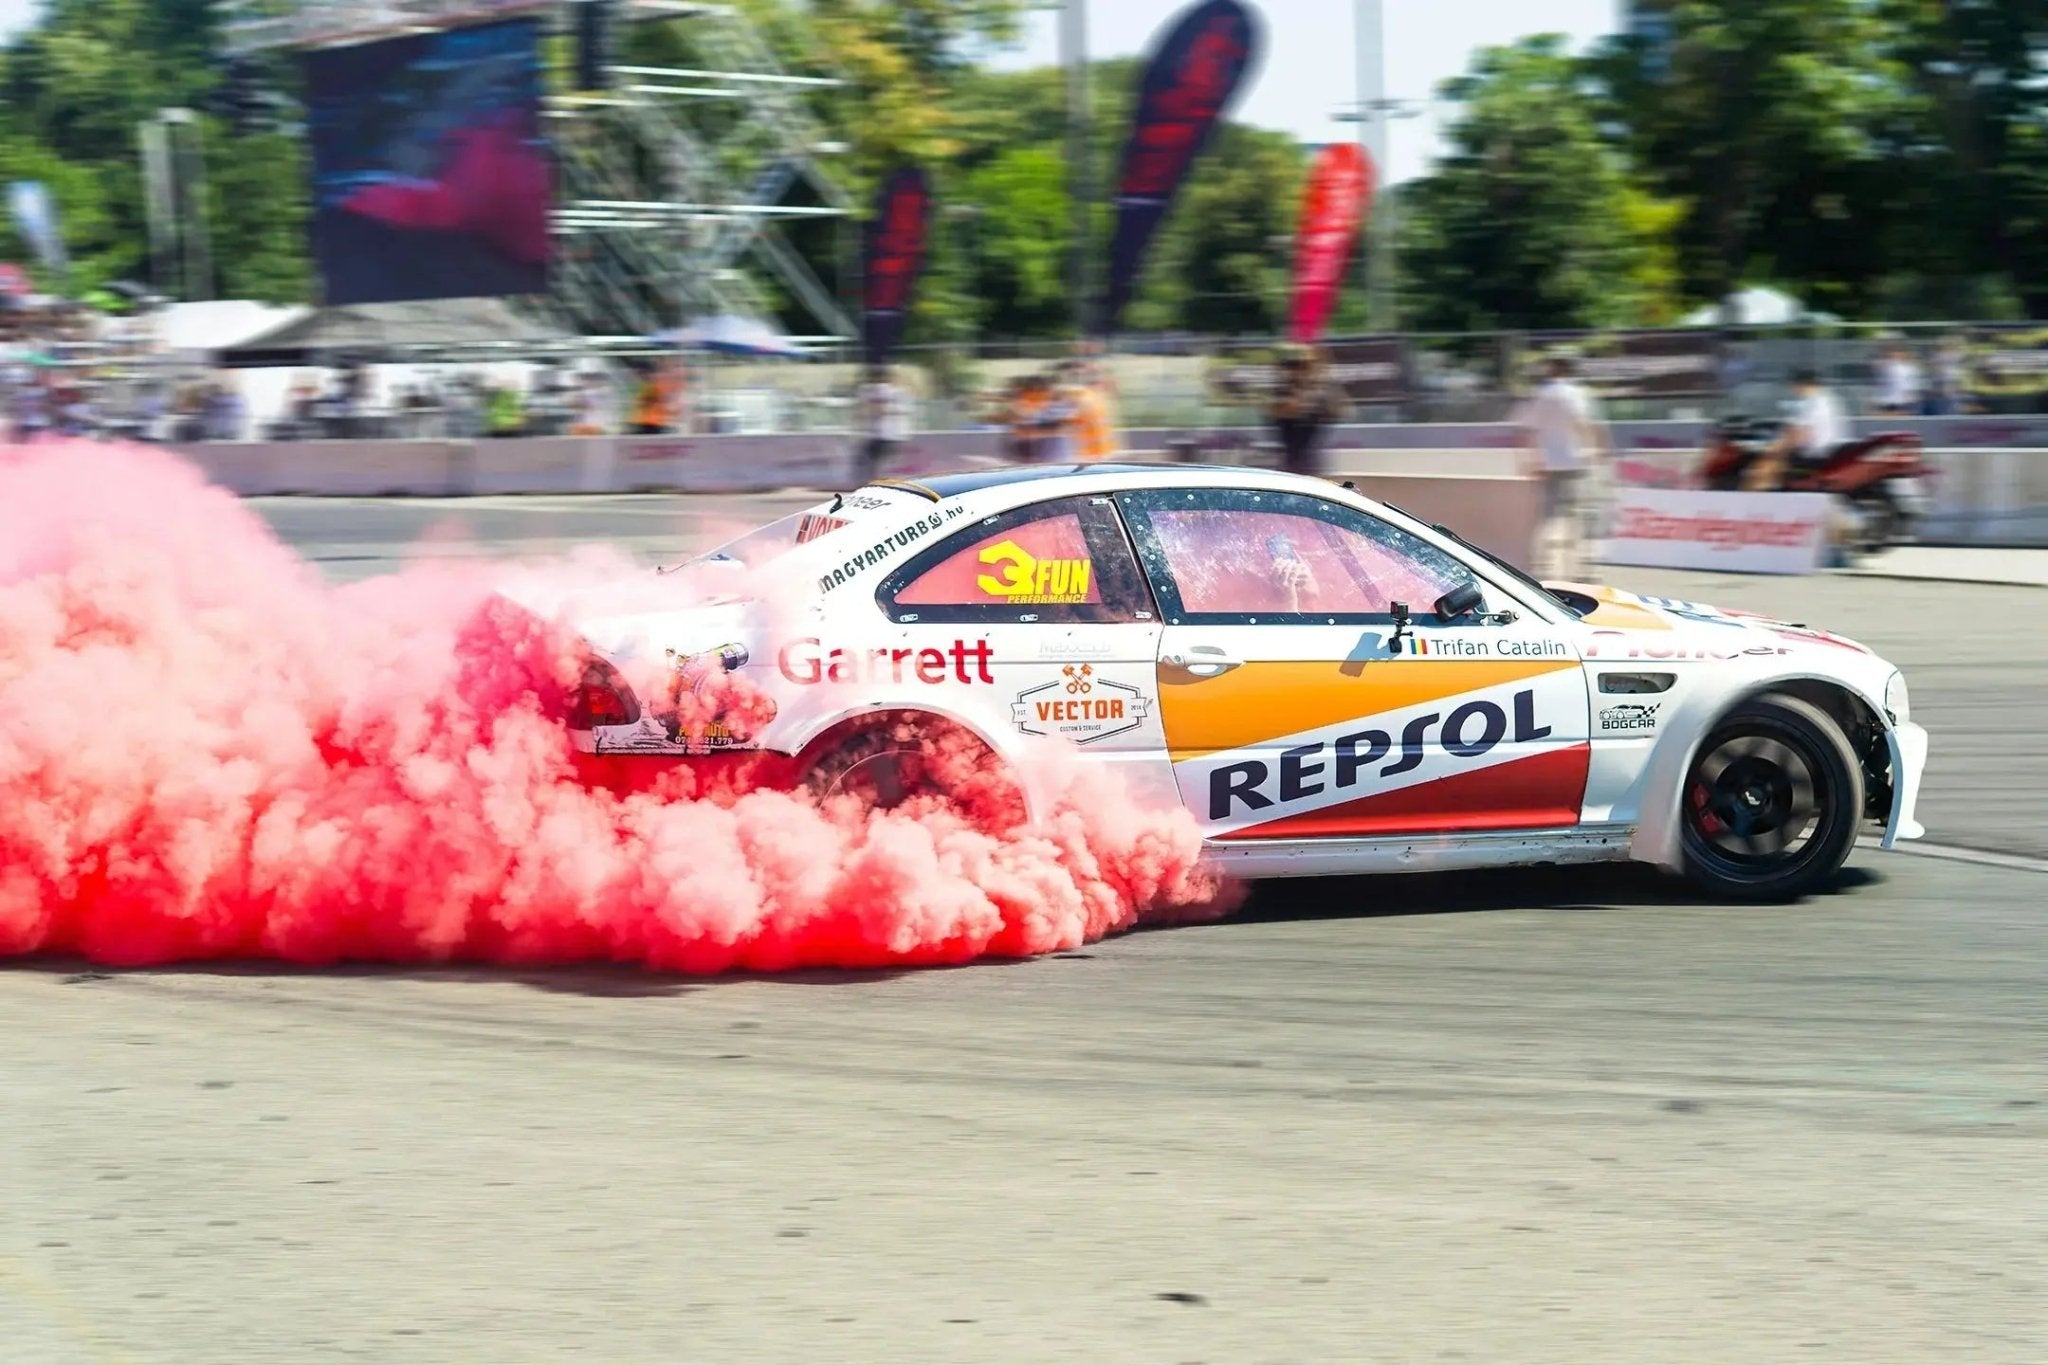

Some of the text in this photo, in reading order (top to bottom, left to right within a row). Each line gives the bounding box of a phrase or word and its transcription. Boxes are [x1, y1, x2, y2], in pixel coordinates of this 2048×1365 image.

[1007, 593, 1088, 604] PERFORMANCE
[1430, 638, 1489, 656] Trifan
[1496, 638, 1567, 656] Catalin
[778, 637, 994, 685] Garrett
[1035, 699, 1124, 721] VECTOR
[1601, 718, 1656, 730] BOGCAR
[1209, 689, 1552, 820] REPSOL
